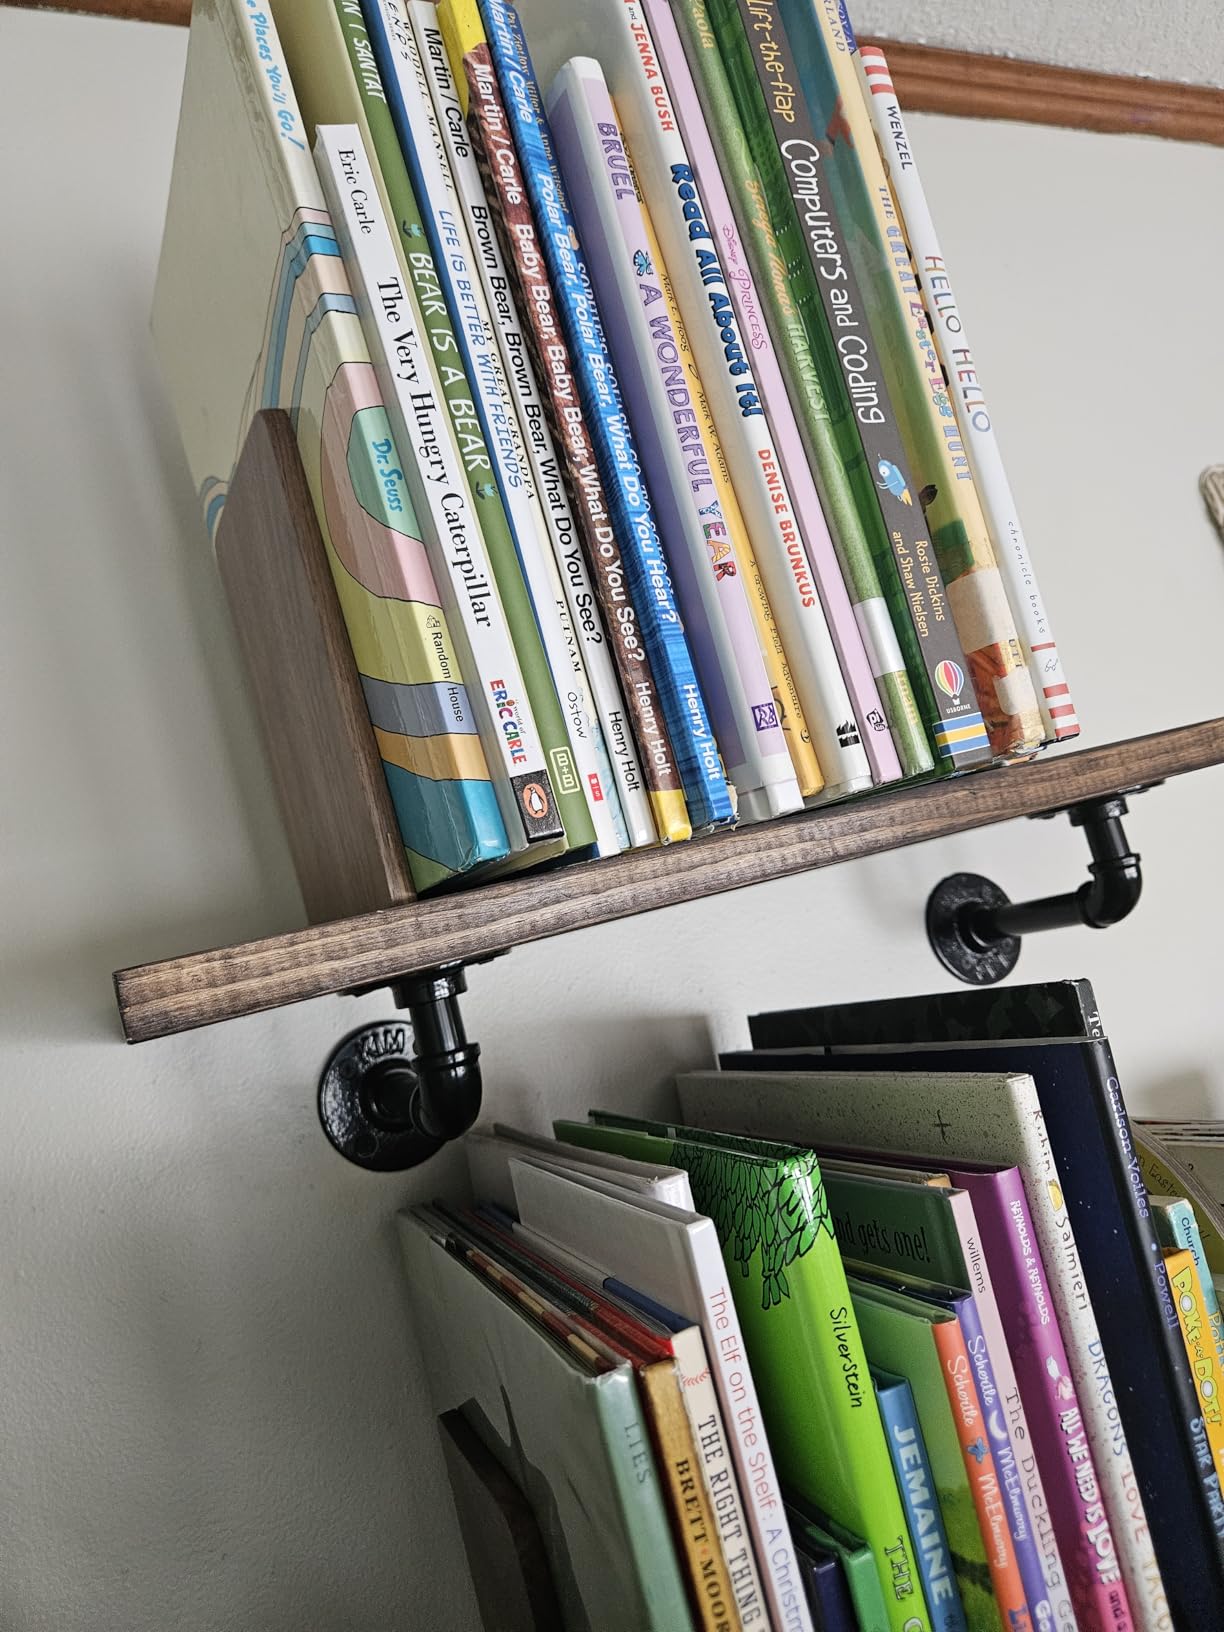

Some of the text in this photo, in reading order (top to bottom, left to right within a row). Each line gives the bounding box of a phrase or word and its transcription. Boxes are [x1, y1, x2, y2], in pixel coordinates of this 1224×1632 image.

[250, 12, 273, 62] Places
[266, 65, 287, 105] You'll
[277, 109, 305, 150] Go!
[354, 37, 386, 104] SANTAT
[403, 22, 454, 191] WADDELL MANSELL
[424, 27, 469, 158] Martin Carle
[509, 70, 534, 124] Carle
[630, 23, 658, 80] JENNA
[650, 86, 674, 132] BUSH
[472, 63, 523, 205] Martin Carle
[597, 122, 634, 200] BRUEL
[886, 106, 913, 170] WENZEL
[338, 149, 375, 235] Eric Carle
[537, 172, 563, 229] Polar
[554, 232, 578, 286] Bear,
[640, 283, 663, 307] A
[671, 163, 764, 417] Read All About It!
[781, 139, 886, 424] Computers and Coding
[439, 210, 523, 488] LIFE IS BETTER WITH FRIENDS
[571, 291, 597, 348] Polar
[661, 273, 690, 353] Mark Hoog
[879, 185, 973, 481] THE GREAT Easter Egg HUNT
[925, 256, 992, 433] HELLO HELLO
[410, 252, 490, 472] BEAR IS A BEAR
[588, 353, 613, 408] Bear,
[649, 315, 713, 492] WONDERFUL
[787, 324, 832, 425] HARVEST
[377, 276, 491, 628] The Very Hungry Caterpillar
[471, 205, 603, 644] Brown Bear, Brown Bear, What Do You See?
[490, 352, 513, 408] GREAT
[507, 416, 535, 499] GRANDPA
[515, 224, 646, 662] Baby Bear, Baby Bear, What Do You See?
[606, 414, 632, 470] What
[697, 391, 730, 484] Mark W. Adams
[372, 438, 403, 513] Dr. Seuss
[623, 474, 642, 508] Do
[632, 513, 655, 553] You
[698, 500, 737, 582] YEAR
[758, 449, 816, 608] DENISE BRUNKUS
[647, 559, 678, 624] Hear?
[753, 574, 773, 622] Growing
[892, 531, 930, 638] and Shaw Nielsen
[915, 540, 945, 622] Rosie Dickins
[1008, 521, 1046, 634] chronicle books
[431, 632, 464, 722] Random House
[556, 600, 582, 673] PUTNAM
[490, 679, 527, 764] ERIC CARLE
[567, 691, 588, 738] Ostow
[608, 711, 641, 792] Henry Holt
[635, 681, 673, 777] Henry Holt
[683, 683, 721, 781] Henry Holt
[946, 703, 972, 714] USBORNE
[857, 1219, 931, 1264] gets one!
[1106, 1076, 1180, 1330] Carlson-Voiles Powell
[1181, 1217, 1200, 1267] Church
[967, 1238, 987, 1294] willems
[1010, 1200, 1050, 1326] REYNOLDS & REYNOLDS
[1056, 1216, 1088, 1311] Salmieri
[829, 1307, 863, 1408] Silverstein
[709, 1287, 784, 1545] The Elf on the Shelf: A
[1088, 1338, 1151, 1543] DRAGONS LOVE
[675, 1460, 710, 1544] BRETT
[698, 1414, 761, 1625] THE RIGHT THING
[894, 1425, 953, 1606] JEMAINE
[1005, 1387, 1025, 1441] The
[1022, 1455, 1062, 1588] Duckling
[1059, 1408, 1121, 1585] ALL WE NEED IS LOVE
[885, 1535, 914, 1601] THE
